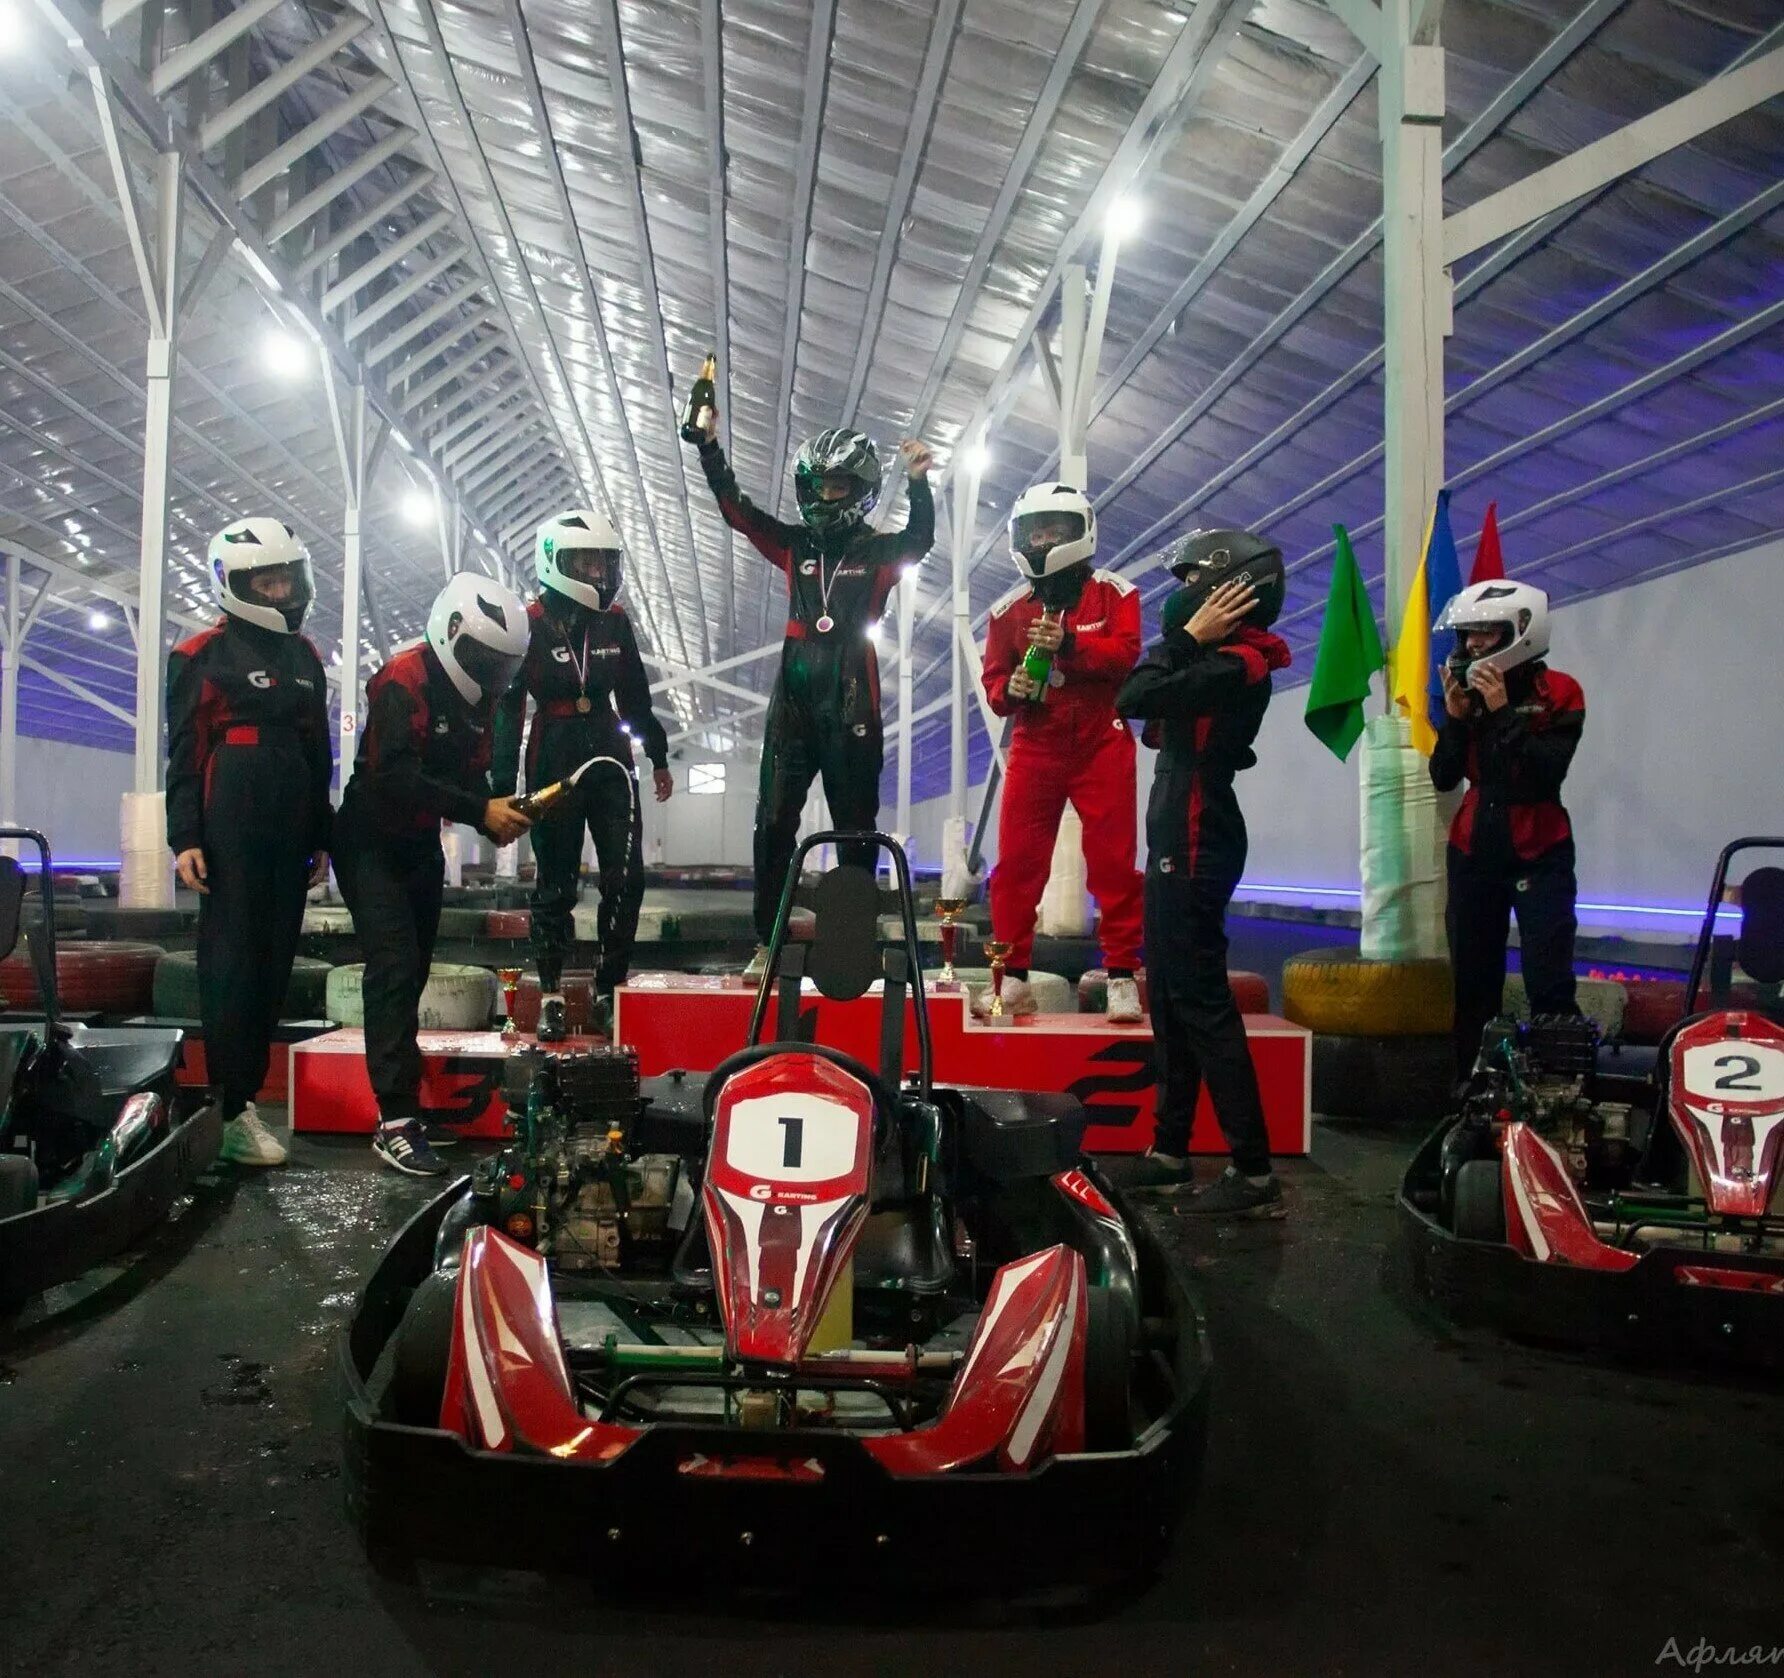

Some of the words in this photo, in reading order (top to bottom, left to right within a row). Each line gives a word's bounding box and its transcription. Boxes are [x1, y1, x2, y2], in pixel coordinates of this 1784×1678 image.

[799, 559, 818, 576] G
[551, 646, 571, 663] G
[247, 670, 271, 689] G
[342, 714, 356, 732] 3
[852, 723, 867, 737] G
[1714, 1055, 1762, 1091] 2
[778, 1117, 804, 1168] 1
[749, 1184, 772, 1200] G
[777, 1192, 818, 1201] KARTING
[773, 1205, 788, 1215] G
